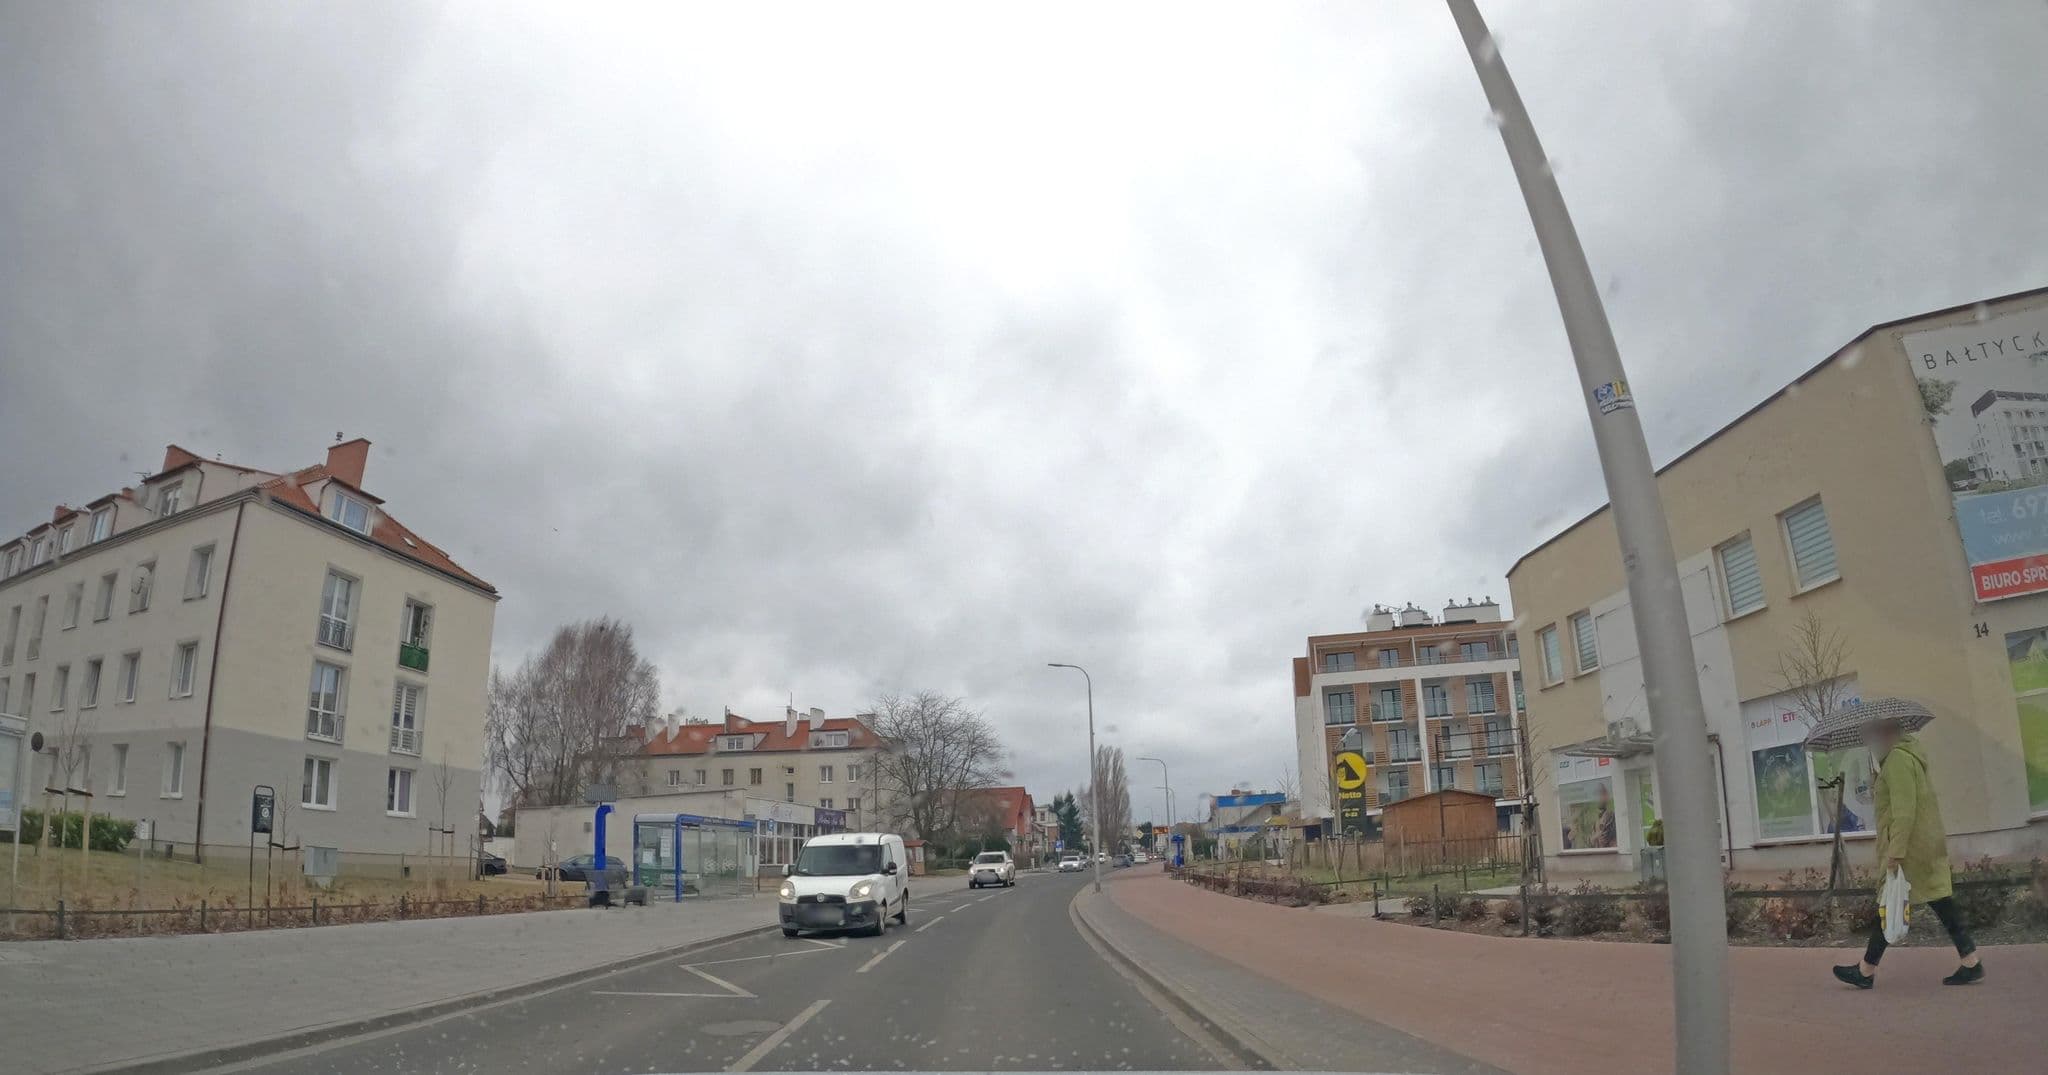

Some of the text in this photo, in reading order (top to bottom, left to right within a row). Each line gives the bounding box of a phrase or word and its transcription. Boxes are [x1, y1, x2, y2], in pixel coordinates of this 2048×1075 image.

[1982, 570, 2021, 591] BIURO
[1973, 621, 1989, 639] 14
[1338, 791, 1362, 800] Netto
